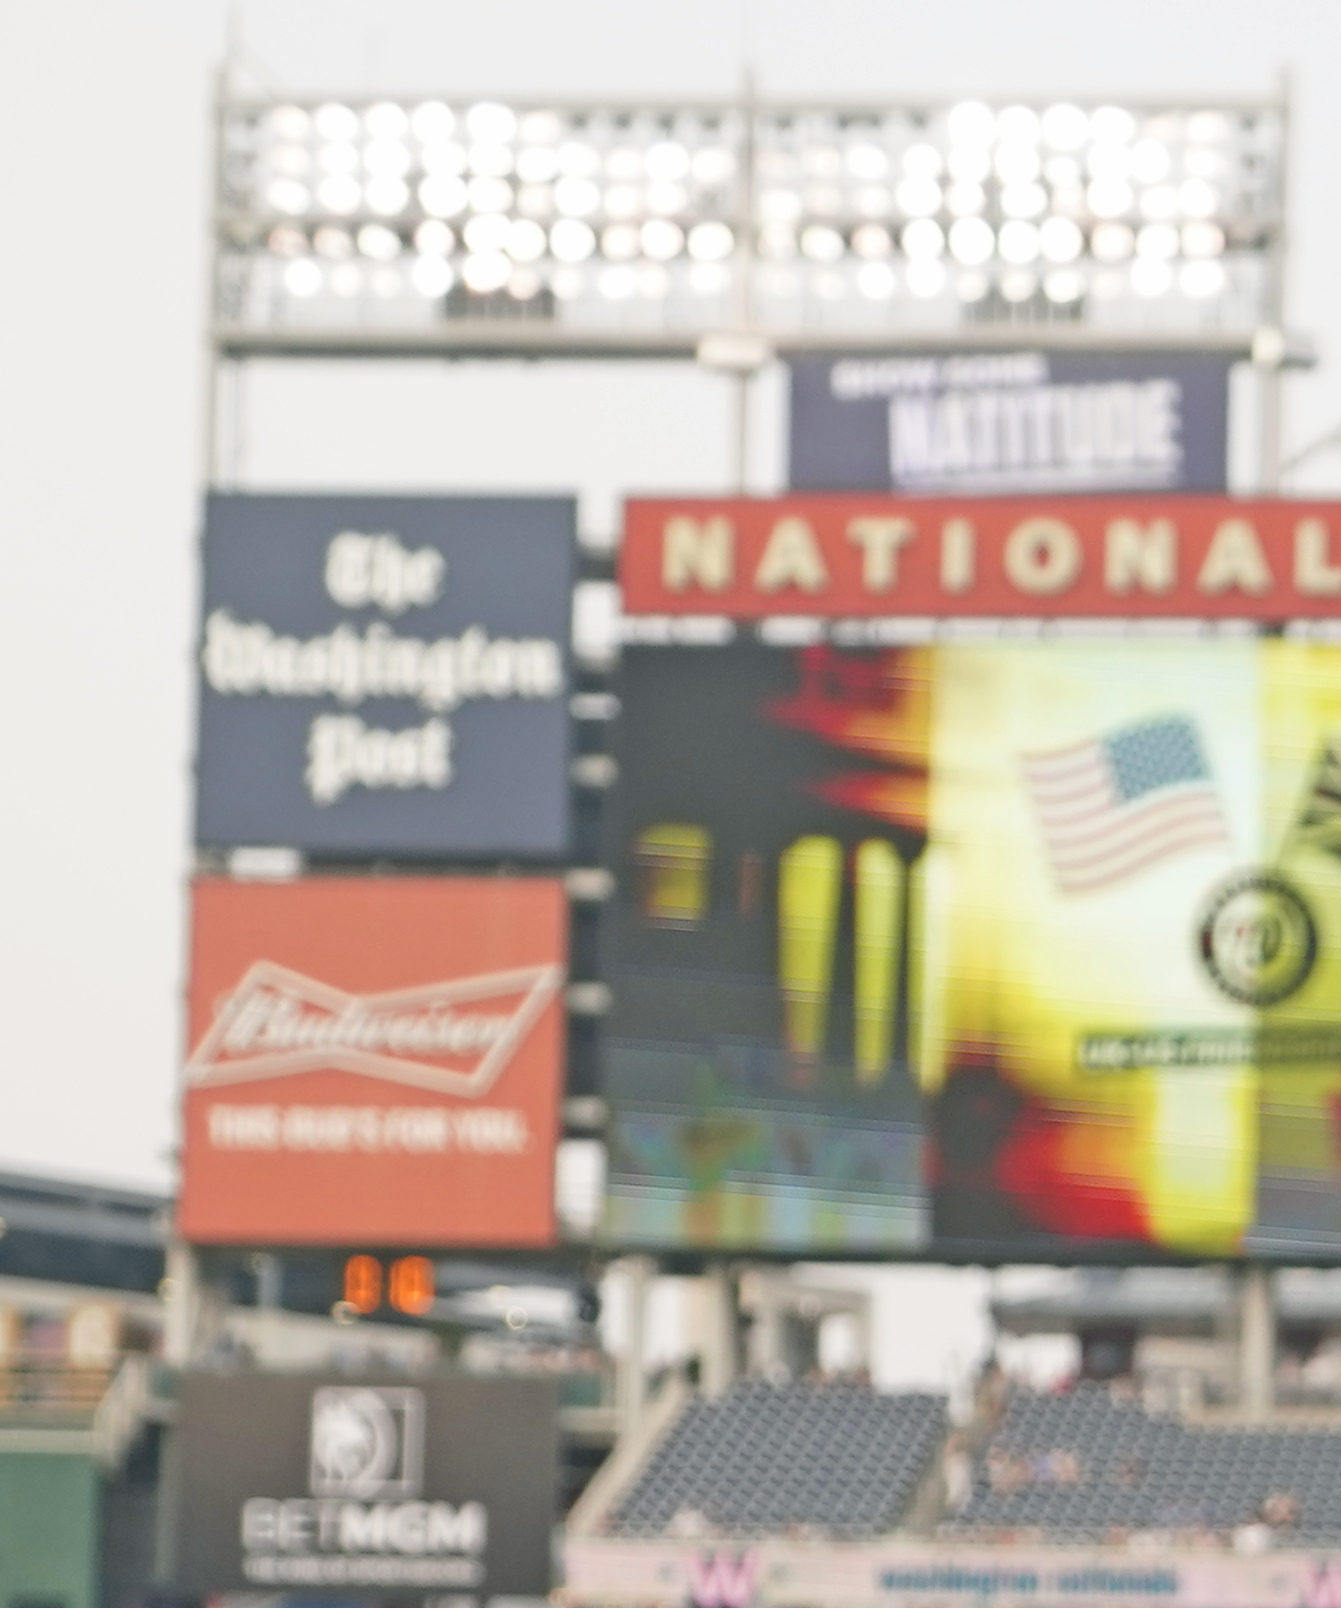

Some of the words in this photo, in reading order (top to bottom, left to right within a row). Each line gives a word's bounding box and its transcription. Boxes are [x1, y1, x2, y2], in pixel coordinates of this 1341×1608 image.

[206, 608, 563, 710] Washington
[307, 714, 453, 804] Post
[243, 1499, 486, 1554] BETMGM
